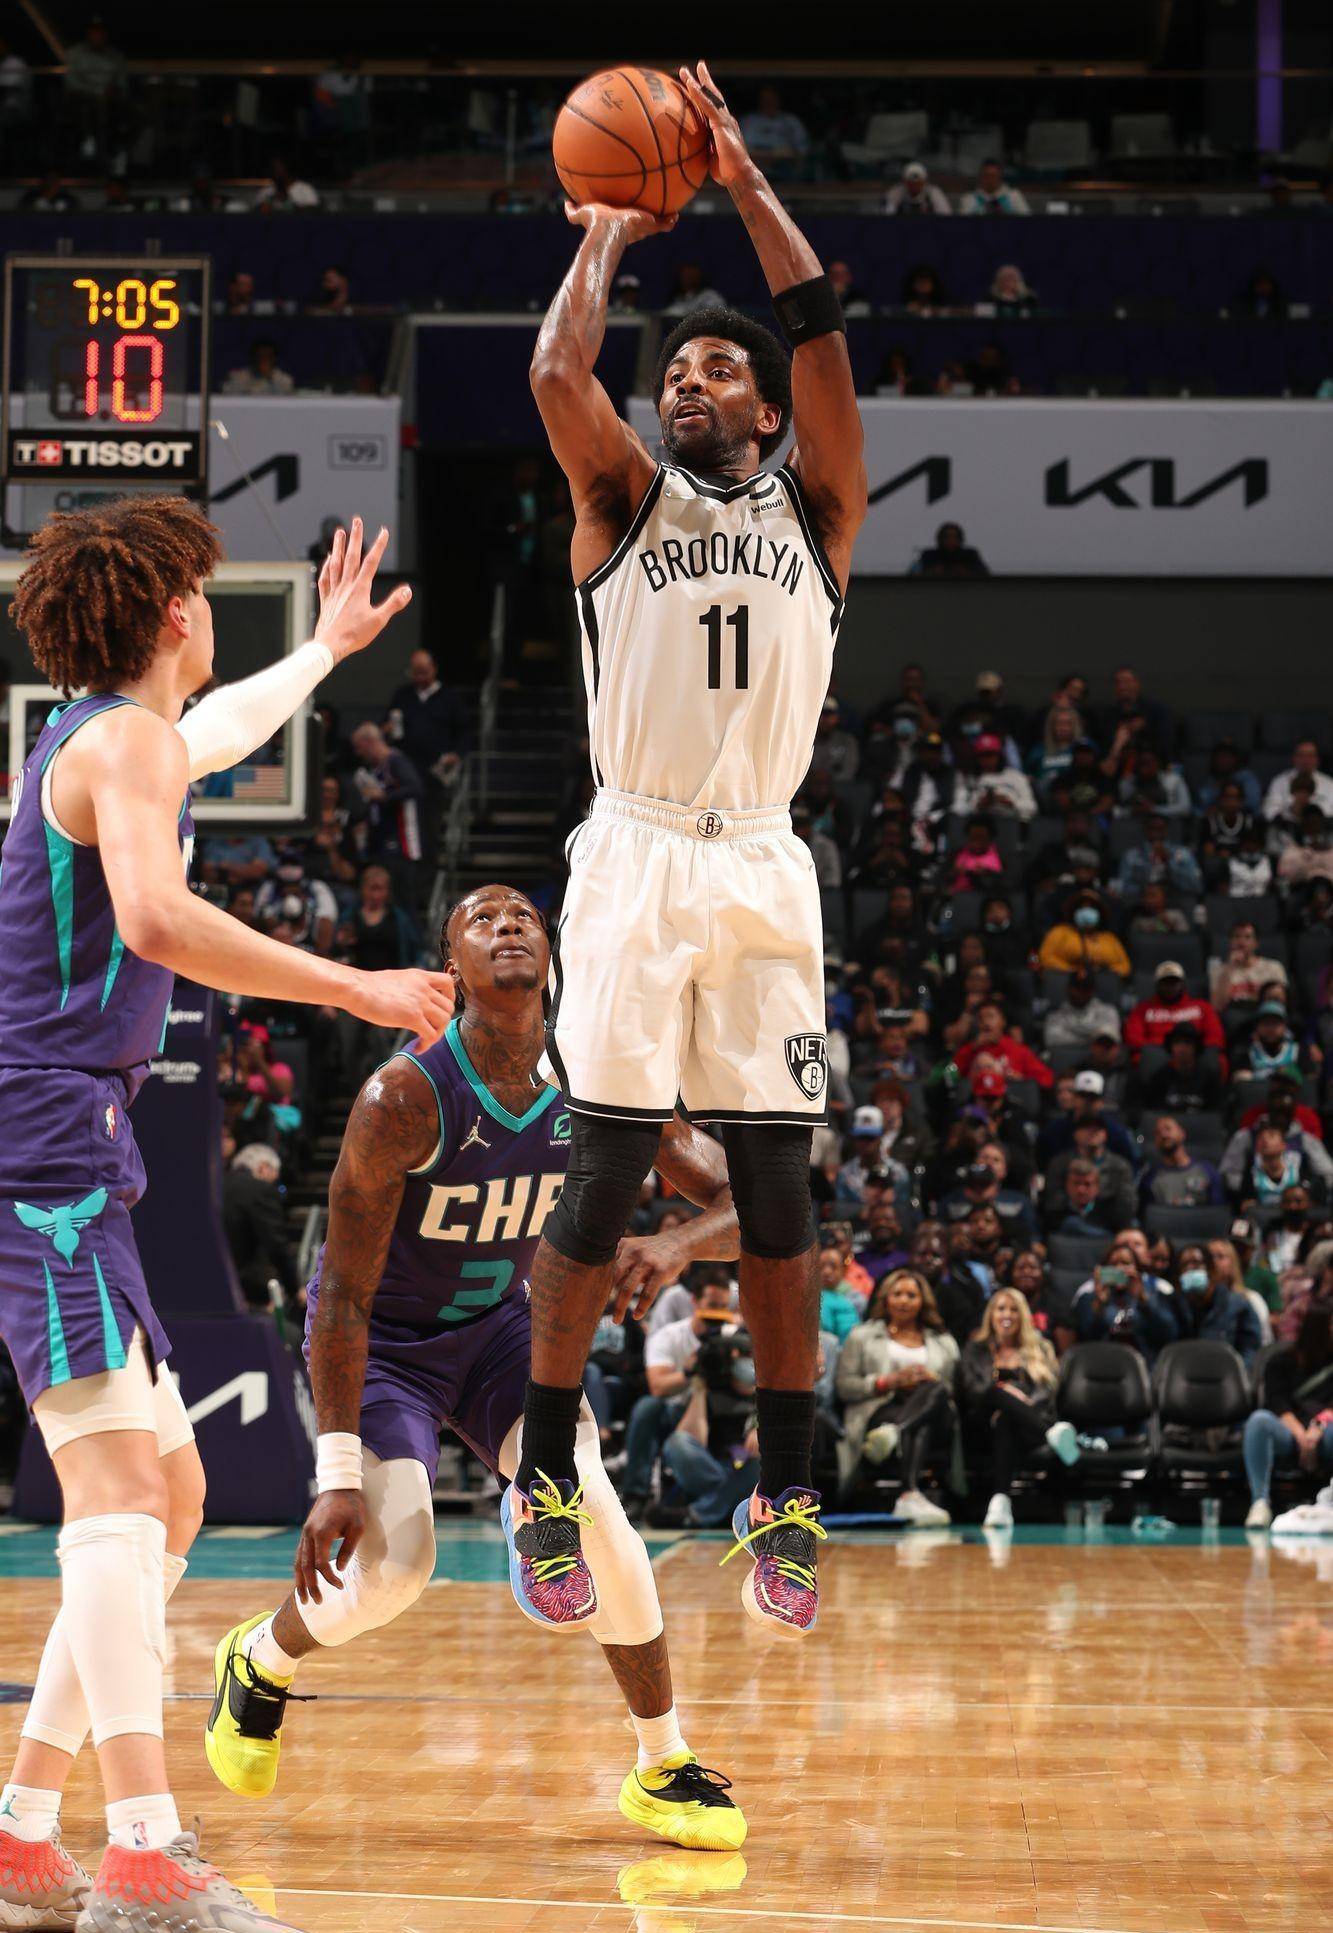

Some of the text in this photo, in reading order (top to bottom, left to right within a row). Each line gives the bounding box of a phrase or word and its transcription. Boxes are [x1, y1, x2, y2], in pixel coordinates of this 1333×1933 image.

[73, 279, 180, 330] 7:05
[85, 335, 164, 422] 10
[64, 441, 192, 467] TISSOT
[338, 443, 378, 462] 109
[1045, 456, 1269, 508] KIA
[639, 532, 803, 596] BROOKLYN
[699, 605, 749, 689] 11
